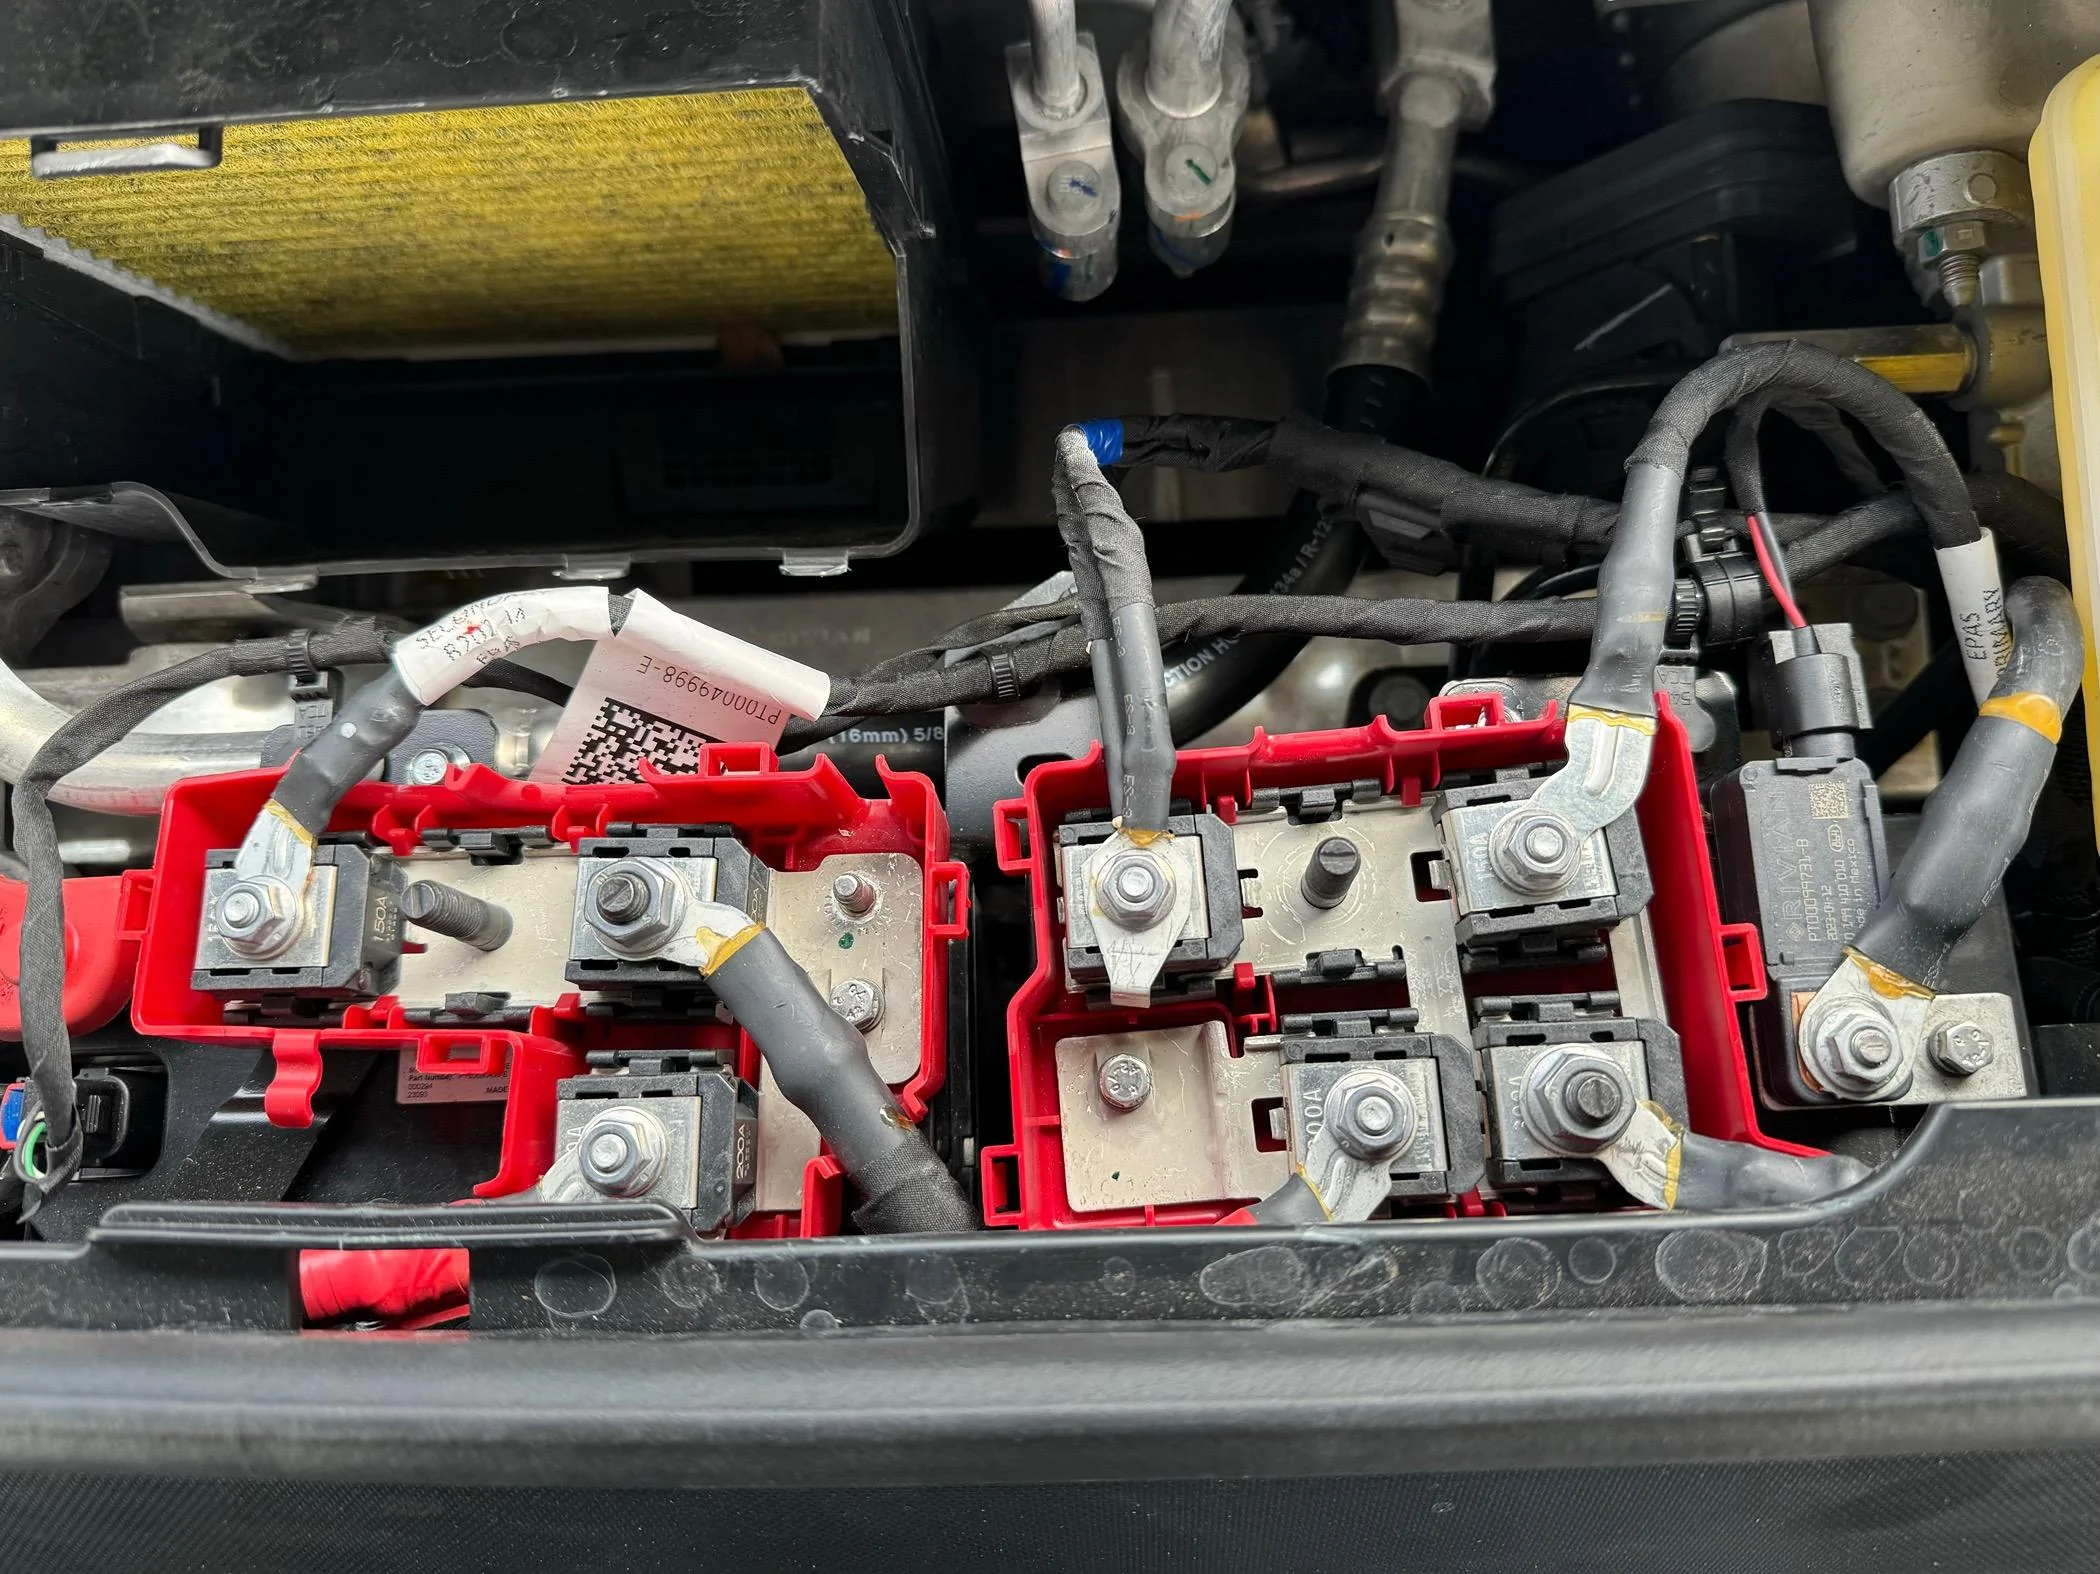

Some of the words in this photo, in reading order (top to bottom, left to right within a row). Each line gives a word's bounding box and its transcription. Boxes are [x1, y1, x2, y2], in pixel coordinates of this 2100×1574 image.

[1299, 517, 1335, 559] R-12
[1960, 612, 1988, 661] EPAS
[636, 655, 782, 726] PT00049998-E
[1766, 791, 1804, 921] RIVIAN
[1847, 838, 1861, 885] Mexico
[1796, 838, 1820, 943] PT00099731-B
[373, 896, 389, 942] 150A
[736, 1123, 746, 1180] 200A
